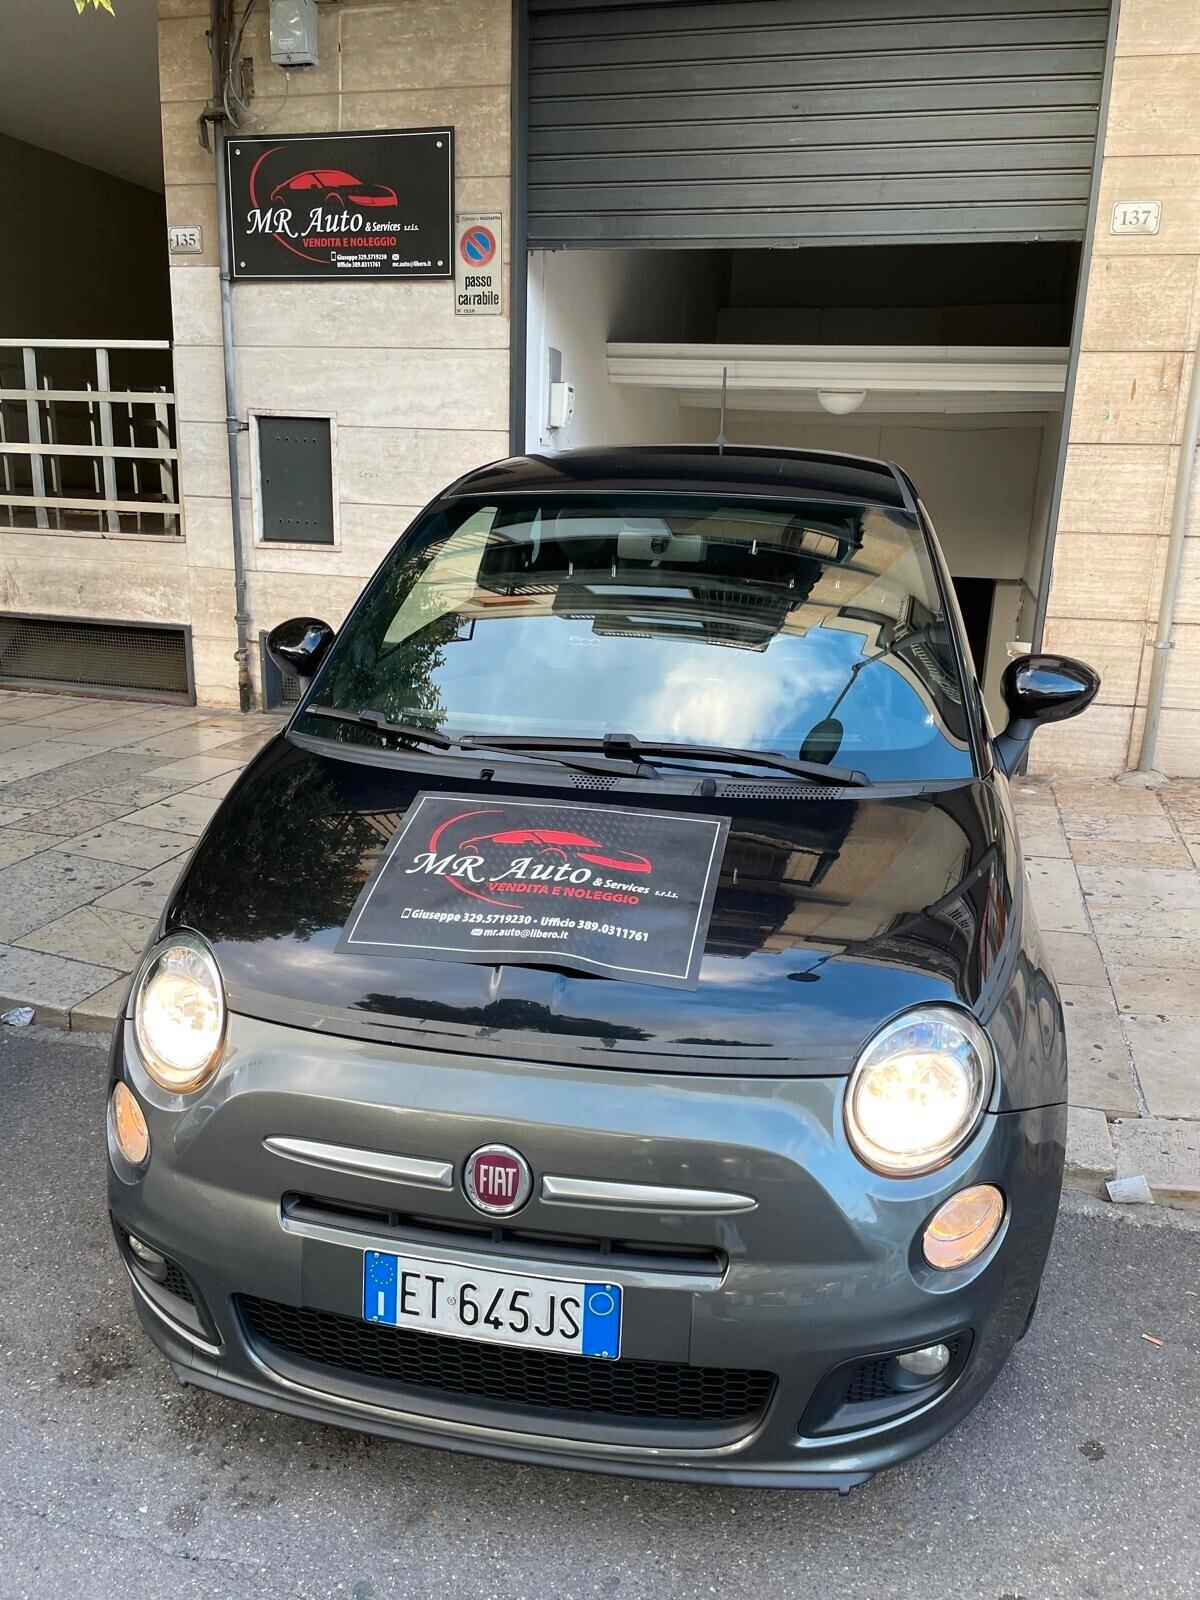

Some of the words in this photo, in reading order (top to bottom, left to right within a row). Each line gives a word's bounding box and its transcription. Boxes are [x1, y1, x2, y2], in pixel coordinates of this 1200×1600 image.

[246, 207, 299, 239] MR
[300, 206, 363, 237] Auto
[365, 221, 371, 232] &
[372, 221, 401, 232] Services
[1120, 209, 1152, 226] 137
[175, 233, 196, 247] 135
[302, 237, 342, 248] VENDITA
[343, 236, 349, 247] E
[350, 236, 397, 247] NOLEGGIO
[336, 253, 358, 262] Giuseppe
[464, 275, 492, 291] passo
[457, 290, 499, 306] carrabile
[405, 852, 486, 883] MR
[488, 856, 593, 884] Auto
[592, 877, 604, 887] &
[603, 879, 651, 895] Services
[488, 882, 550, 895] VENDITA
[551, 886, 562, 896] E
[563, 887, 640, 905] NOLEGGIO
[411, 909, 461, 923] Giuseppe
[462, 912, 533, 925] 329.5719230
[540, 916, 576, 928] Ufficio
[576, 919, 649, 942] 389.0311761
[483, 927, 569, 940] mr.auto@libero.it
[480, 1164, 517, 1197] FIAT
[400, 1271, 445, 1319] ET
